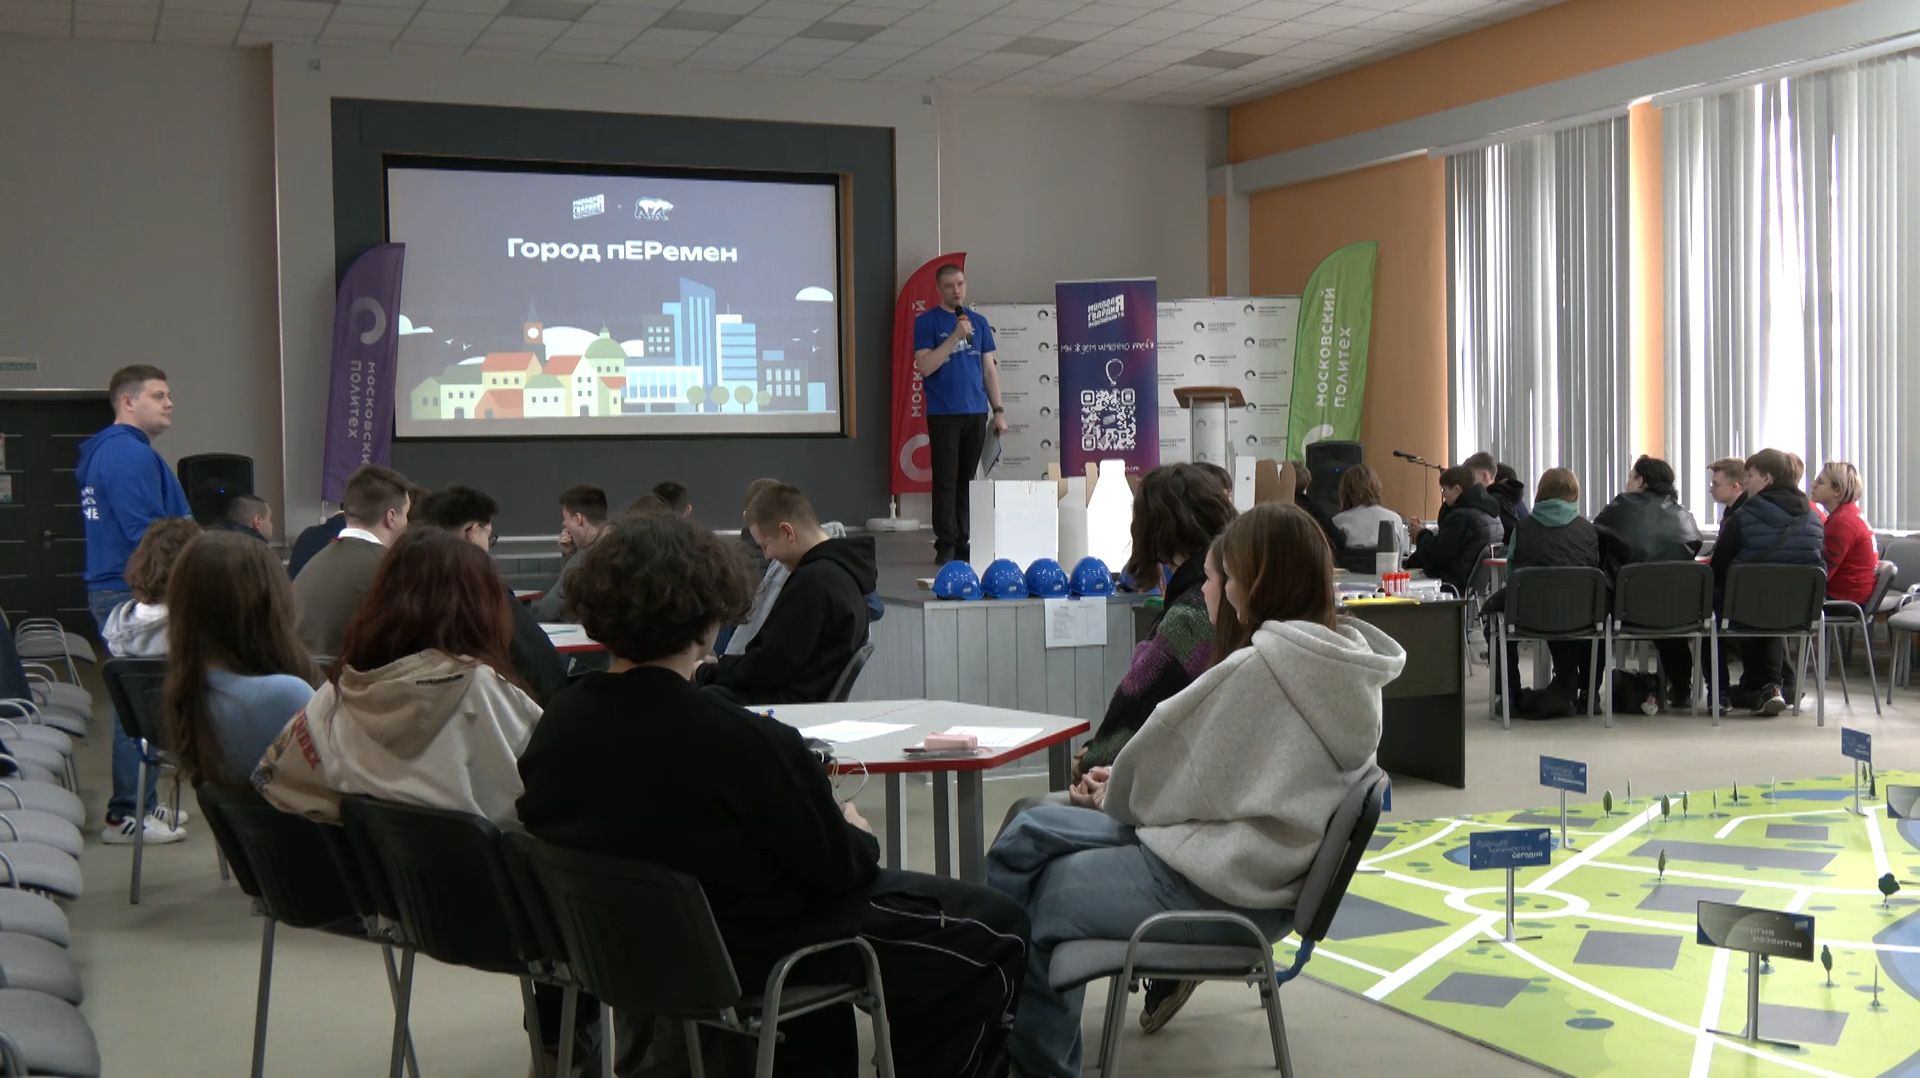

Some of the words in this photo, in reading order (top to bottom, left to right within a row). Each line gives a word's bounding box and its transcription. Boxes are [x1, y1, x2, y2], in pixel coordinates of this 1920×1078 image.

[507, 238, 600, 262] Город
[607, 240, 738, 262] пЕРемен
[1316, 287, 1336, 407] МОСКОВСКИЙ
[361, 362, 375, 465] МОСКОВСКИ
